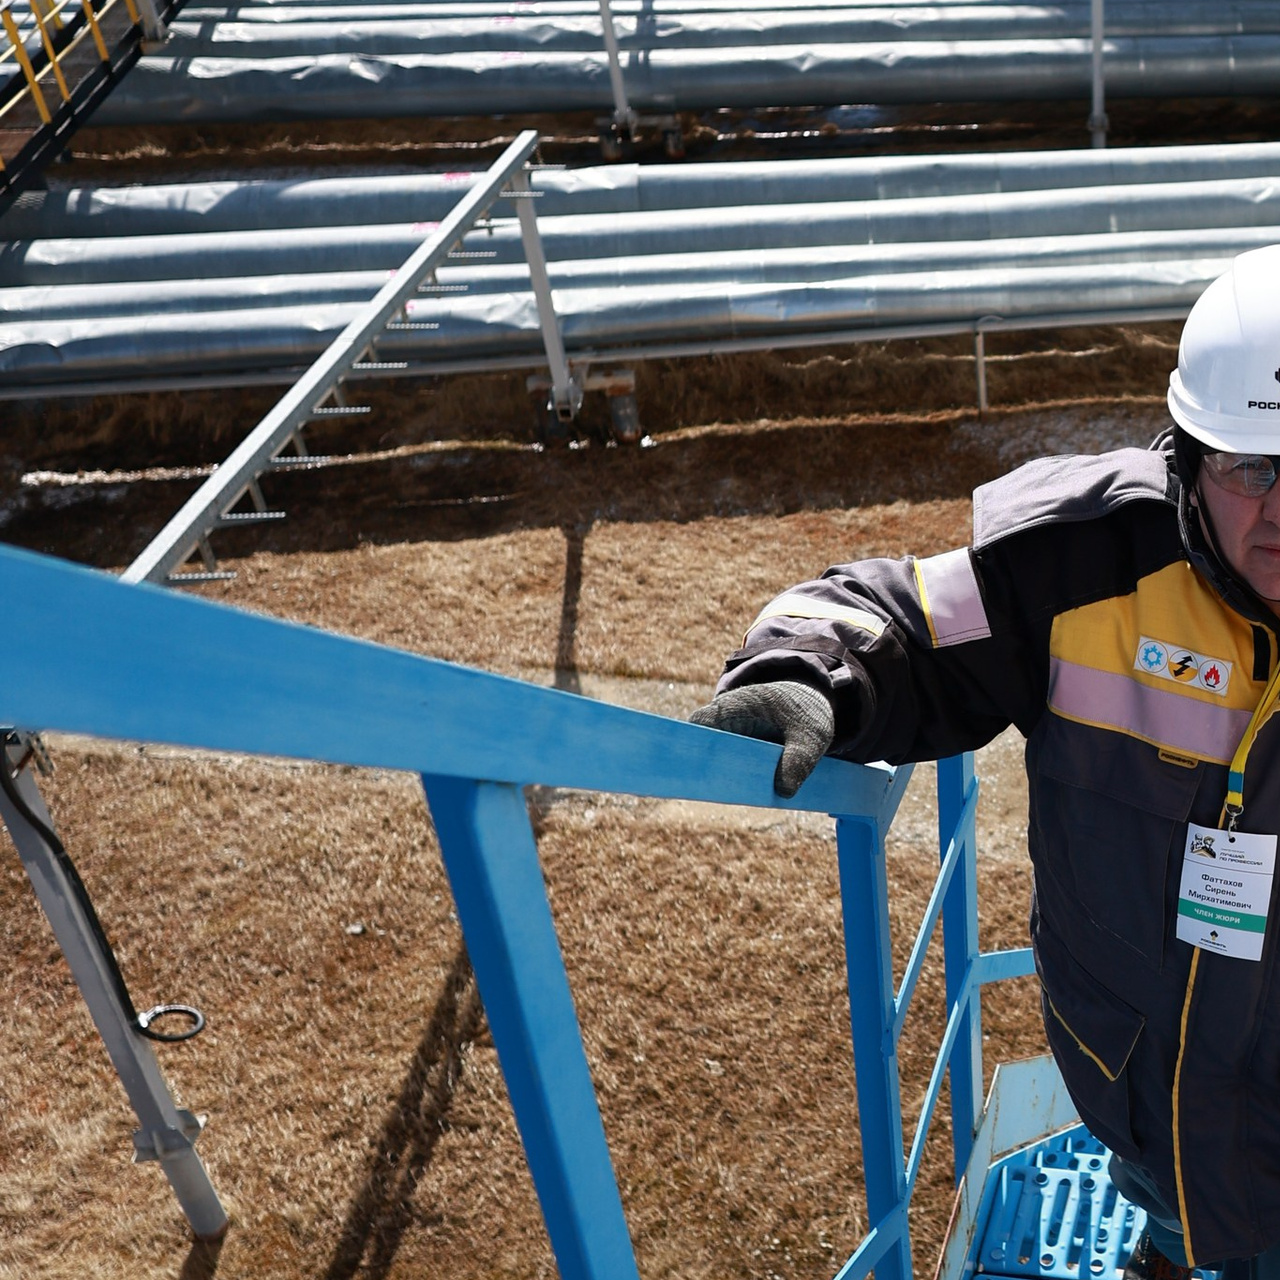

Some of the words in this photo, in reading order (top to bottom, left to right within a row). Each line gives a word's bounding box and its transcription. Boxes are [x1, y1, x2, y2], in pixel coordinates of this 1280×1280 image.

[1201, 873, 1243, 888] Фаттахов
[1205, 884, 1236, 897] Сирень
[1188, 889, 1252, 909] Мирхатимович
[1194, 908, 1214, 918] ЧЛЕН
[1215, 914, 1241, 924] ЖЮРИ
